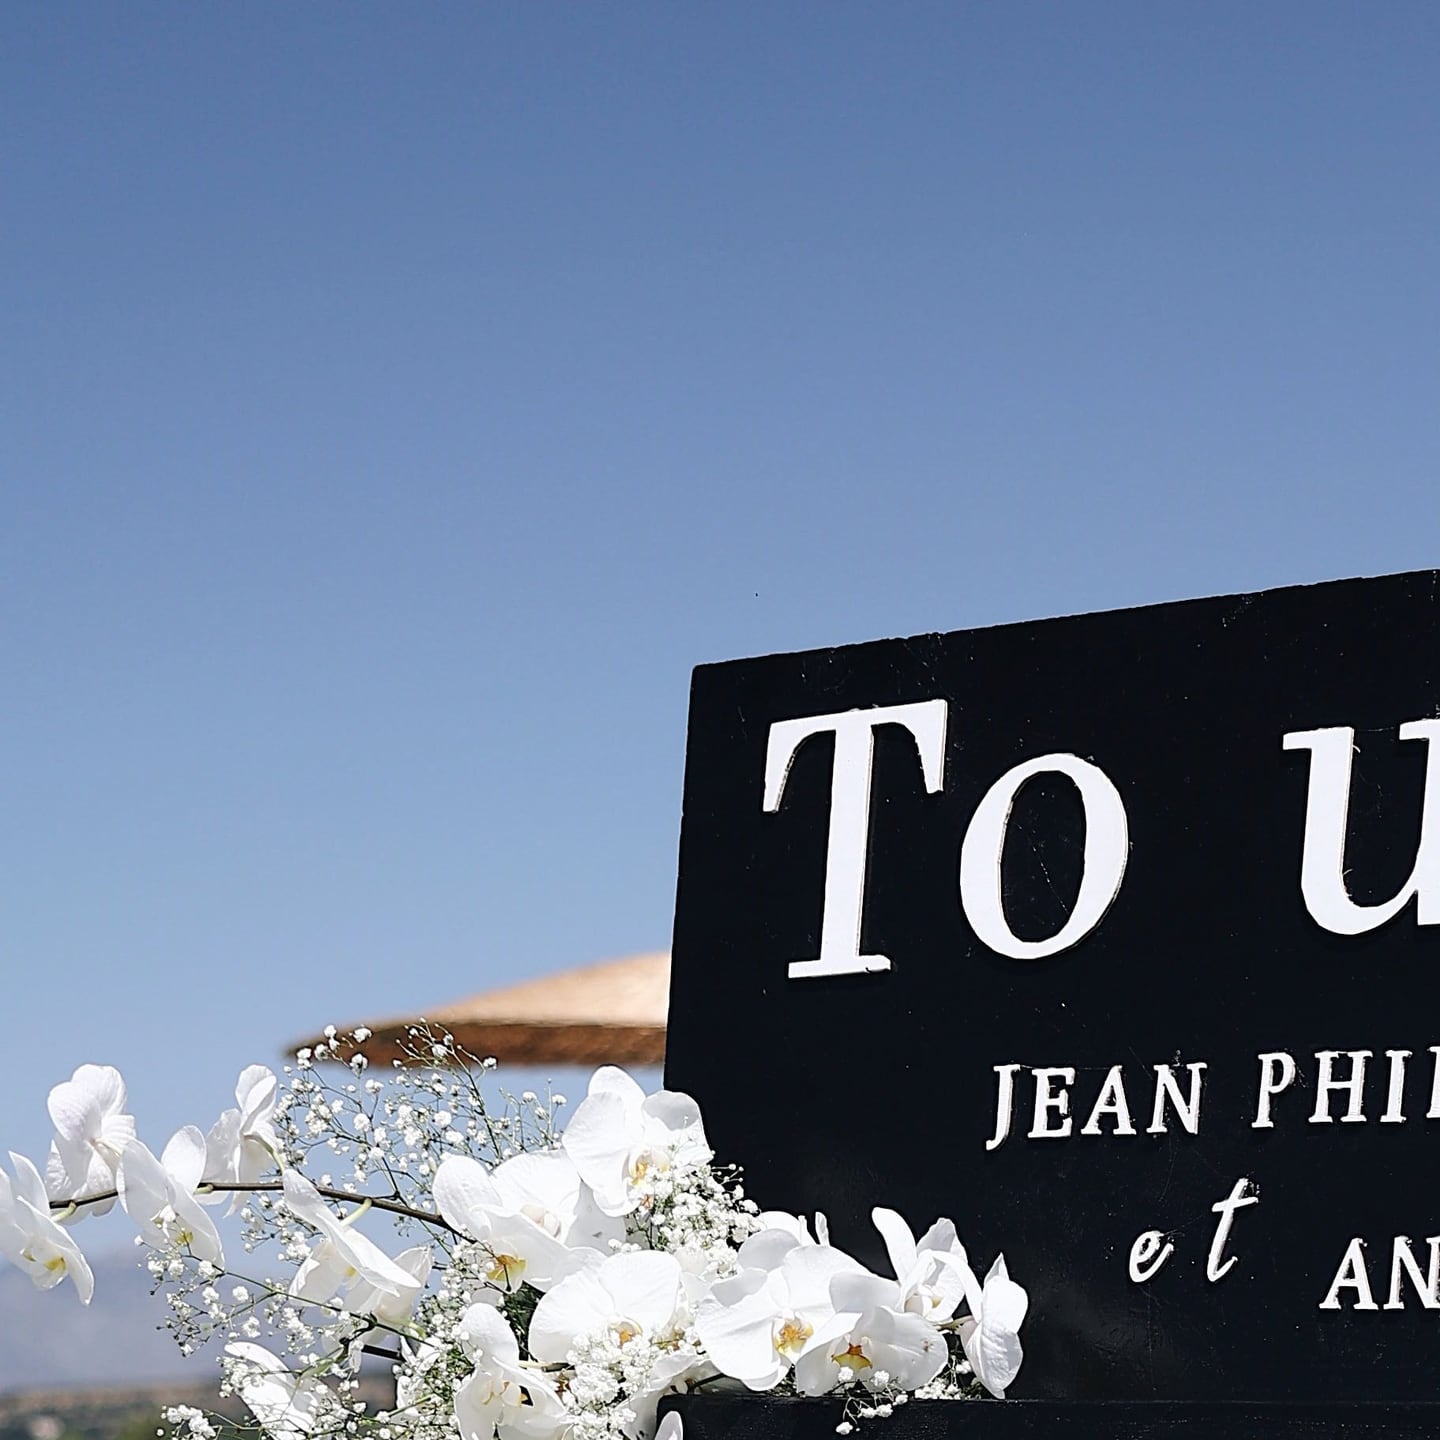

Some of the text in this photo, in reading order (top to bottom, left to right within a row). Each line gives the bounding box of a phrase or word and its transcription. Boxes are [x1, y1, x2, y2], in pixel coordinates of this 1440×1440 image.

[761, 697, 1130, 980] To
[984, 1061, 1209, 1152] JEAN
[1127, 1176, 1260, 1284] et
